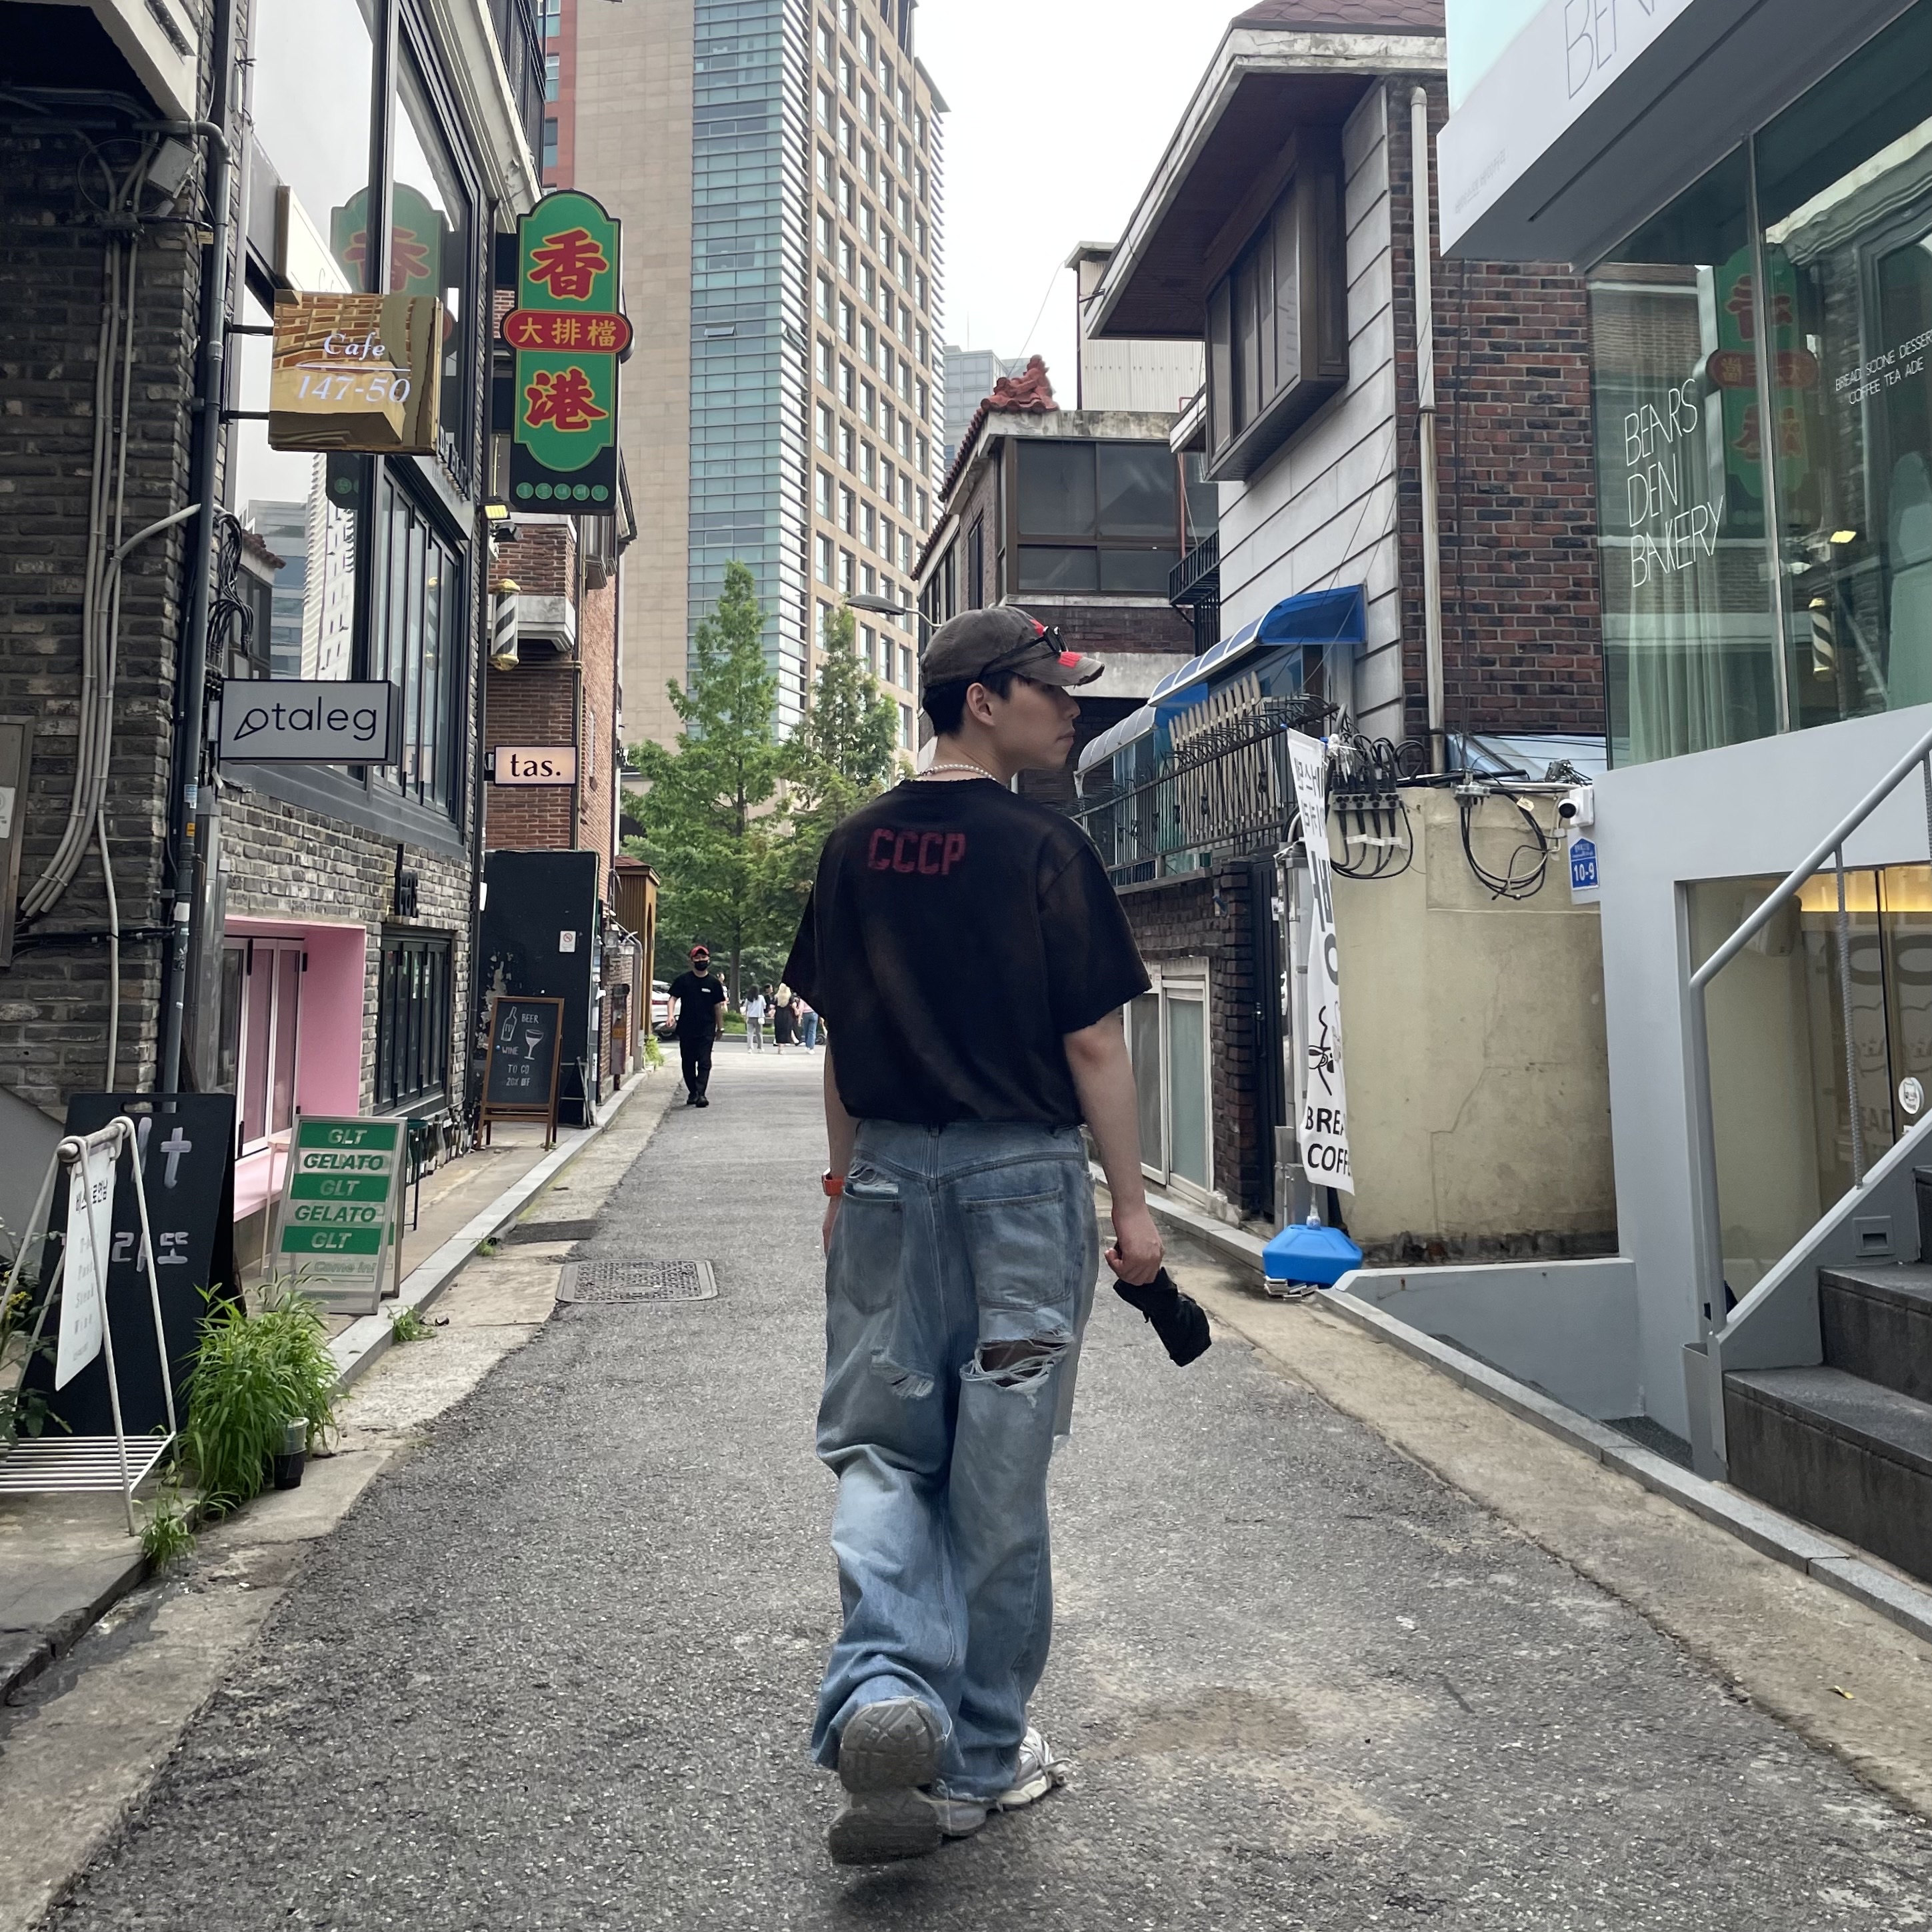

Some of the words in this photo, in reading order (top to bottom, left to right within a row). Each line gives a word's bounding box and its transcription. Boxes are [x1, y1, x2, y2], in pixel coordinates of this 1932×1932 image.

[527, 227, 609, 301] 香
[518, 317, 617, 347] 大排檔
[323, 331, 386, 361] Cafe
[297, 375, 411, 403] 147-50
[1849, 378, 1881, 405] COFFEE
[1884, 368, 1903, 387] TEA
[1905, 356, 1925, 378] ADE
[524, 366, 609, 433] 港
[1624, 377, 1698, 467] BEARS
[1627, 453, 1678, 528] DEN
[1630, 494, 1725, 589] BAKERY
[510, 753, 561, 777] tas.
[868, 828, 966, 875] CCCP
[1573, 863, 1595, 881] 10-9
[521, 1013, 539, 1024] BEER
[501, 1046, 519, 1055] WINE
[508, 1064, 518, 1073] TO
[327, 1128, 368, 1145] GLT
[303, 1153, 384, 1171] GELATO
[319, 1179, 361, 1196] GLT
[294, 1205, 377, 1223] GELATO
[311, 1232, 352, 1249] GLT
